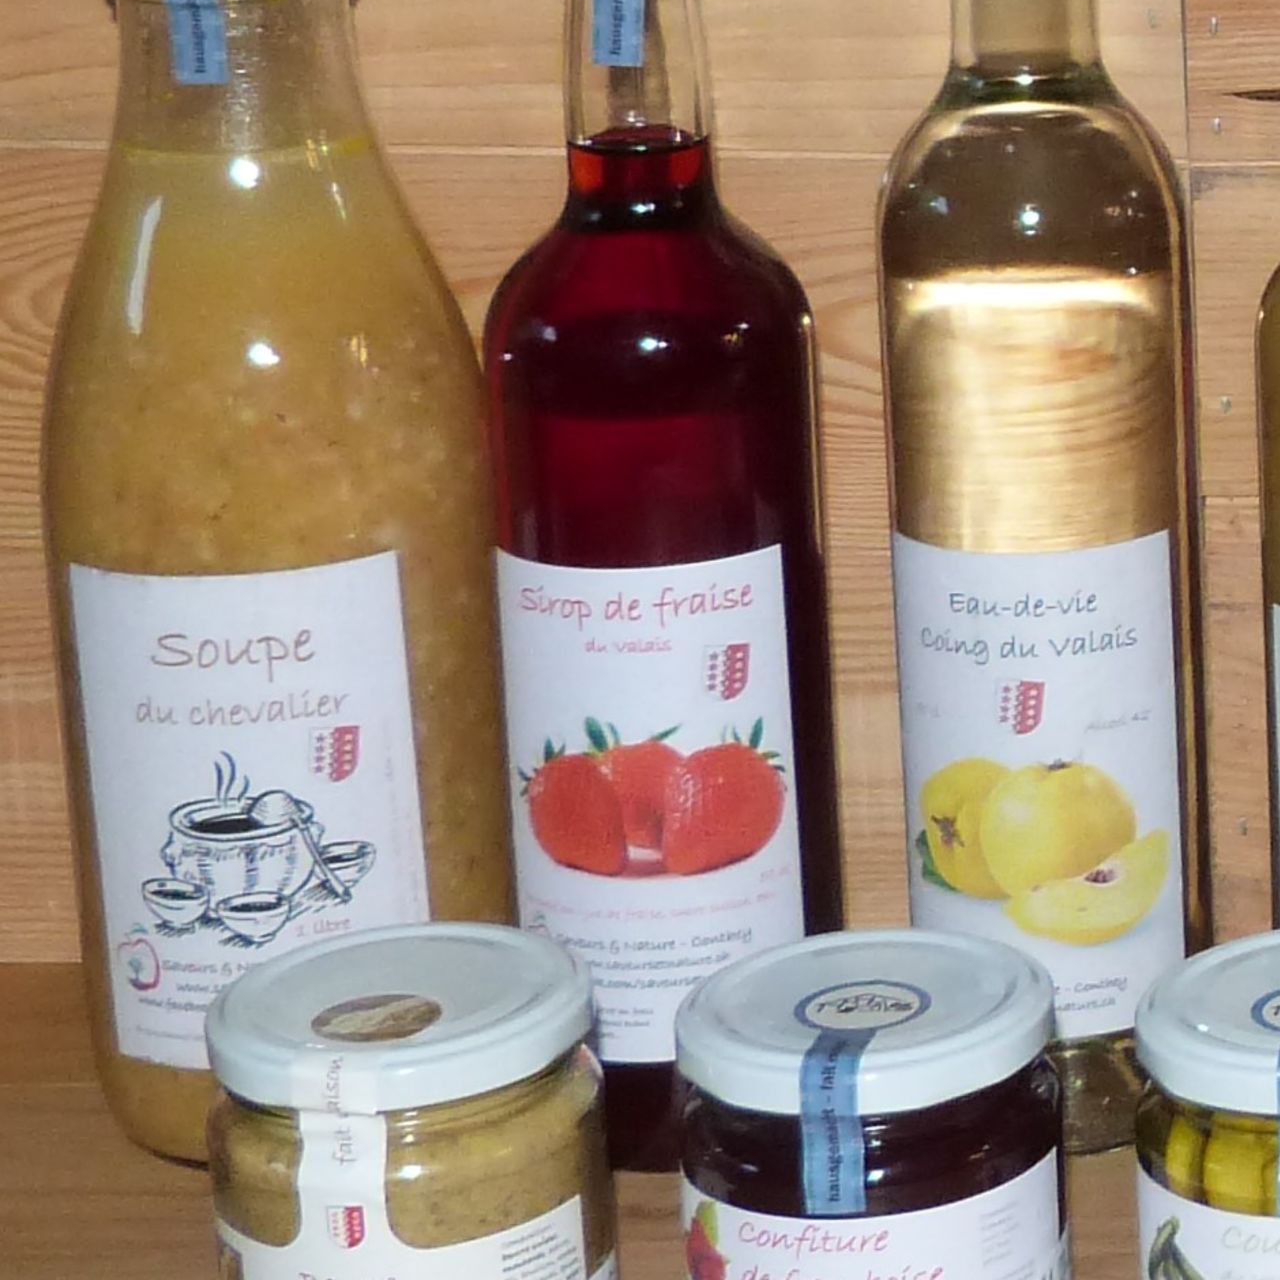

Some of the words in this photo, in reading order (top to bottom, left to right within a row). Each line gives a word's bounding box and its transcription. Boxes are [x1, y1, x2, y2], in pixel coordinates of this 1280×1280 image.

[520, 586, 592, 629] Sirop
[604, 592, 642, 621] de
[656, 583, 753, 626] fraise
[949, 590, 1098, 617] Eau-de-vie
[151, 628, 316, 682] Soupe
[921, 627, 991, 664] Coing
[1000, 637, 1039, 659] du
[136, 697, 179, 724] du
[190, 690, 350, 726] chevalier
[826, 1107, 844, 1203] hausgemacht
[738, 1221, 890, 1260] Confiture
